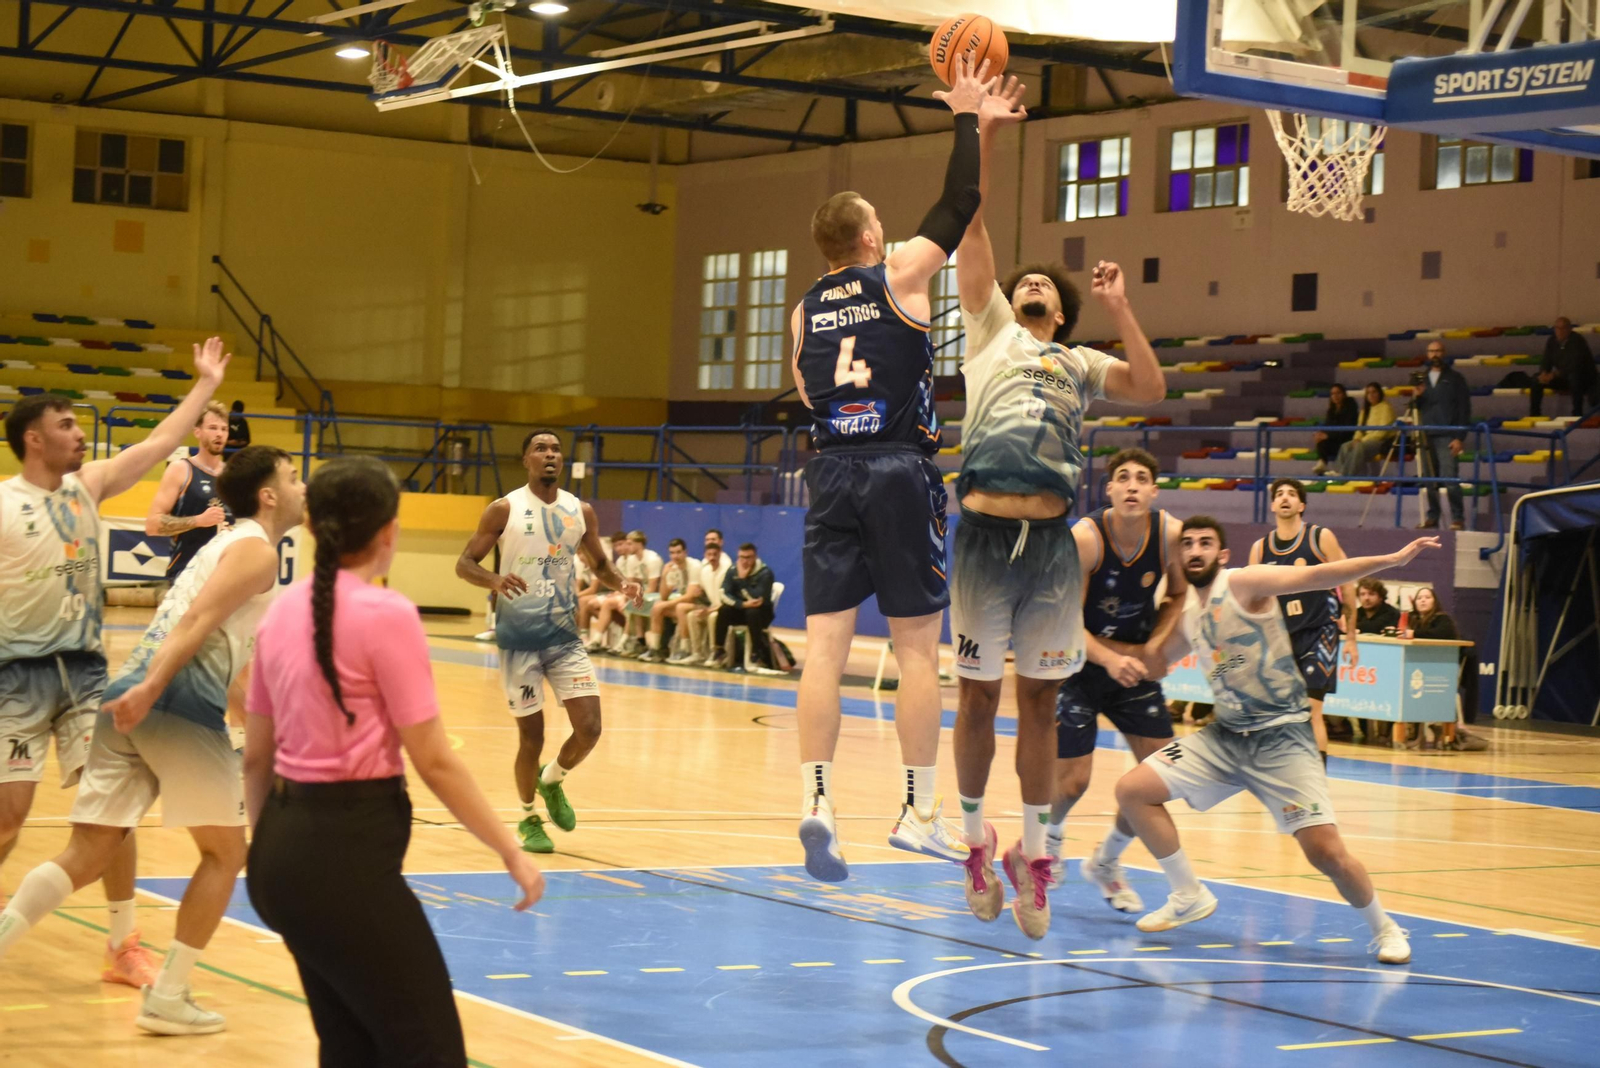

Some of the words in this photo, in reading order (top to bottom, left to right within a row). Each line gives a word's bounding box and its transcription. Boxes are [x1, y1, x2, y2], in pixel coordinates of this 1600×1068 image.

[935, 18, 966, 64] Wilson
[1504, 59, 1596, 96] SYSTEM
[838, 302, 881, 327] STROG
[834, 335, 873, 389] 4
[535, 578, 556, 597] 35
[60, 592, 87, 621] 49
